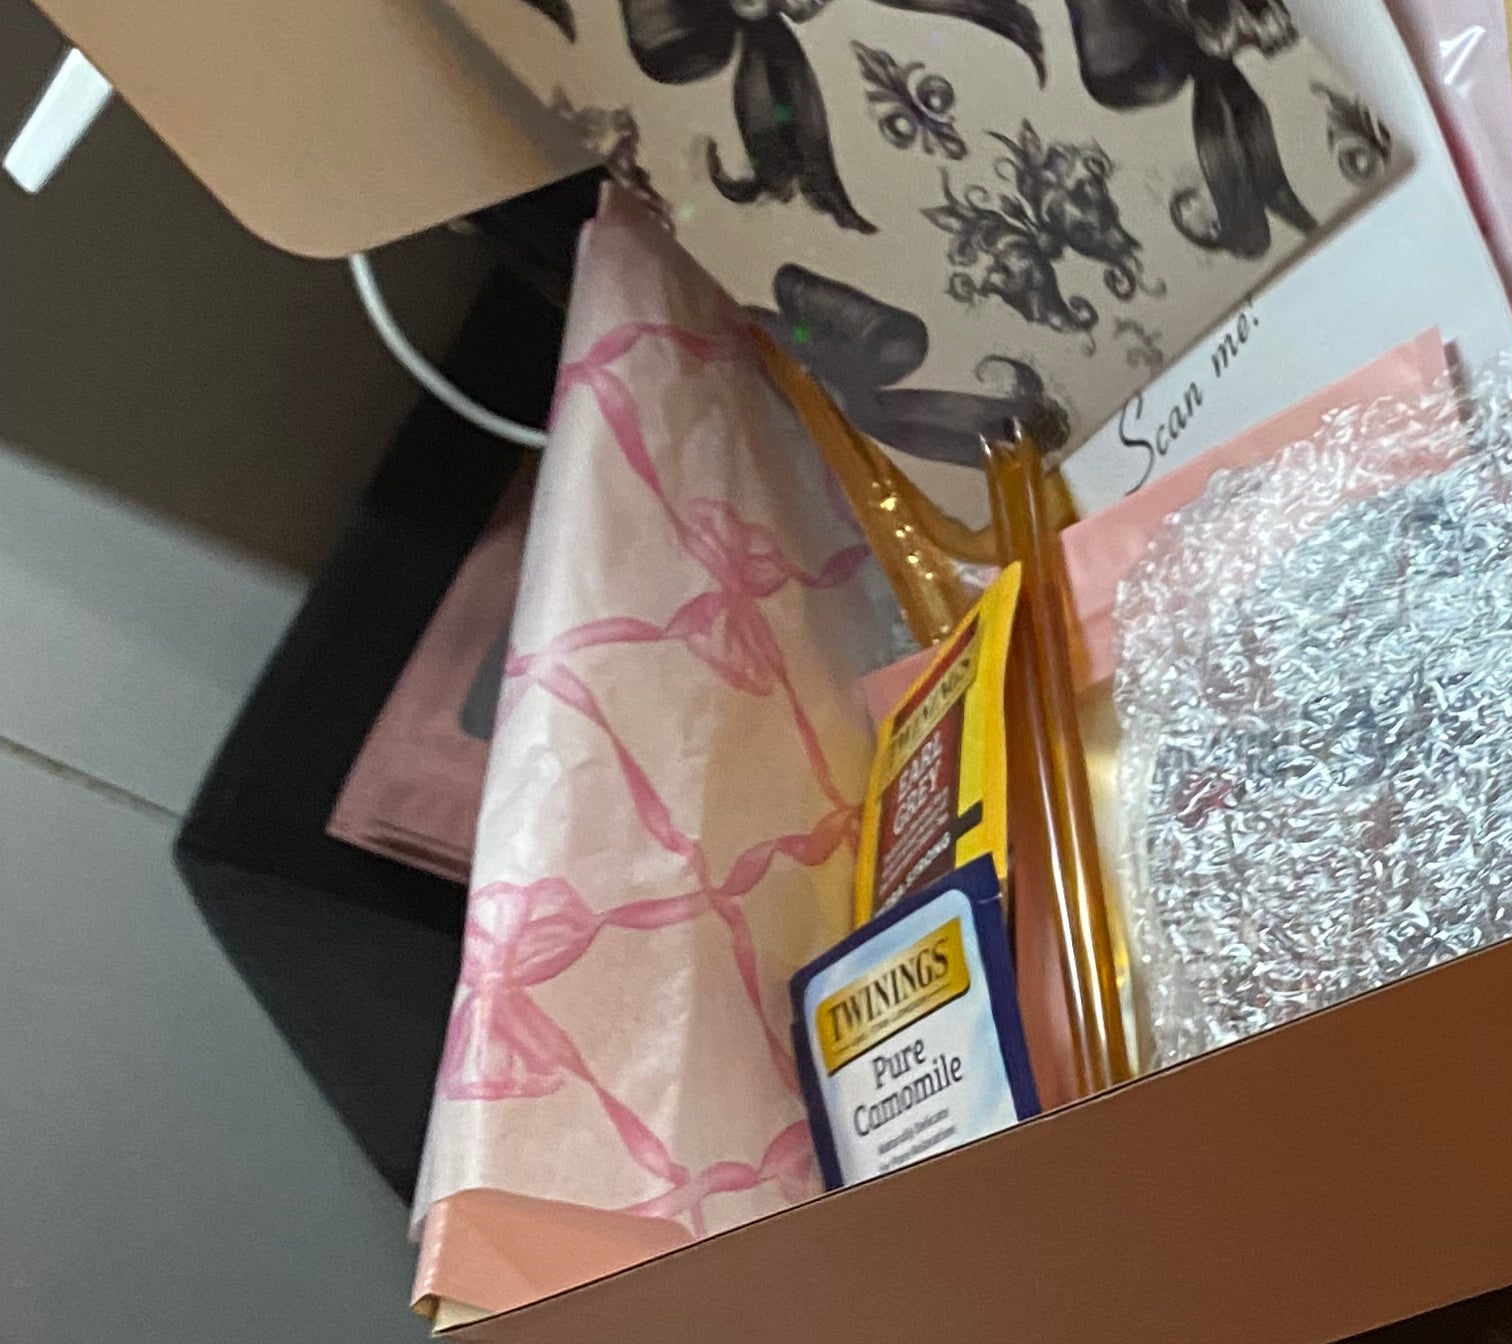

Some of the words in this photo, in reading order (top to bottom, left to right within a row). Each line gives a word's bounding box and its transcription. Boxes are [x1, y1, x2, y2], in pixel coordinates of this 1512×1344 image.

[1118, 382, 1204, 497] Scan
[828, 937, 950, 1042] TWININGS
[853, 1054, 963, 1137] Camomile
[871, 1038, 926, 1090] Pure
